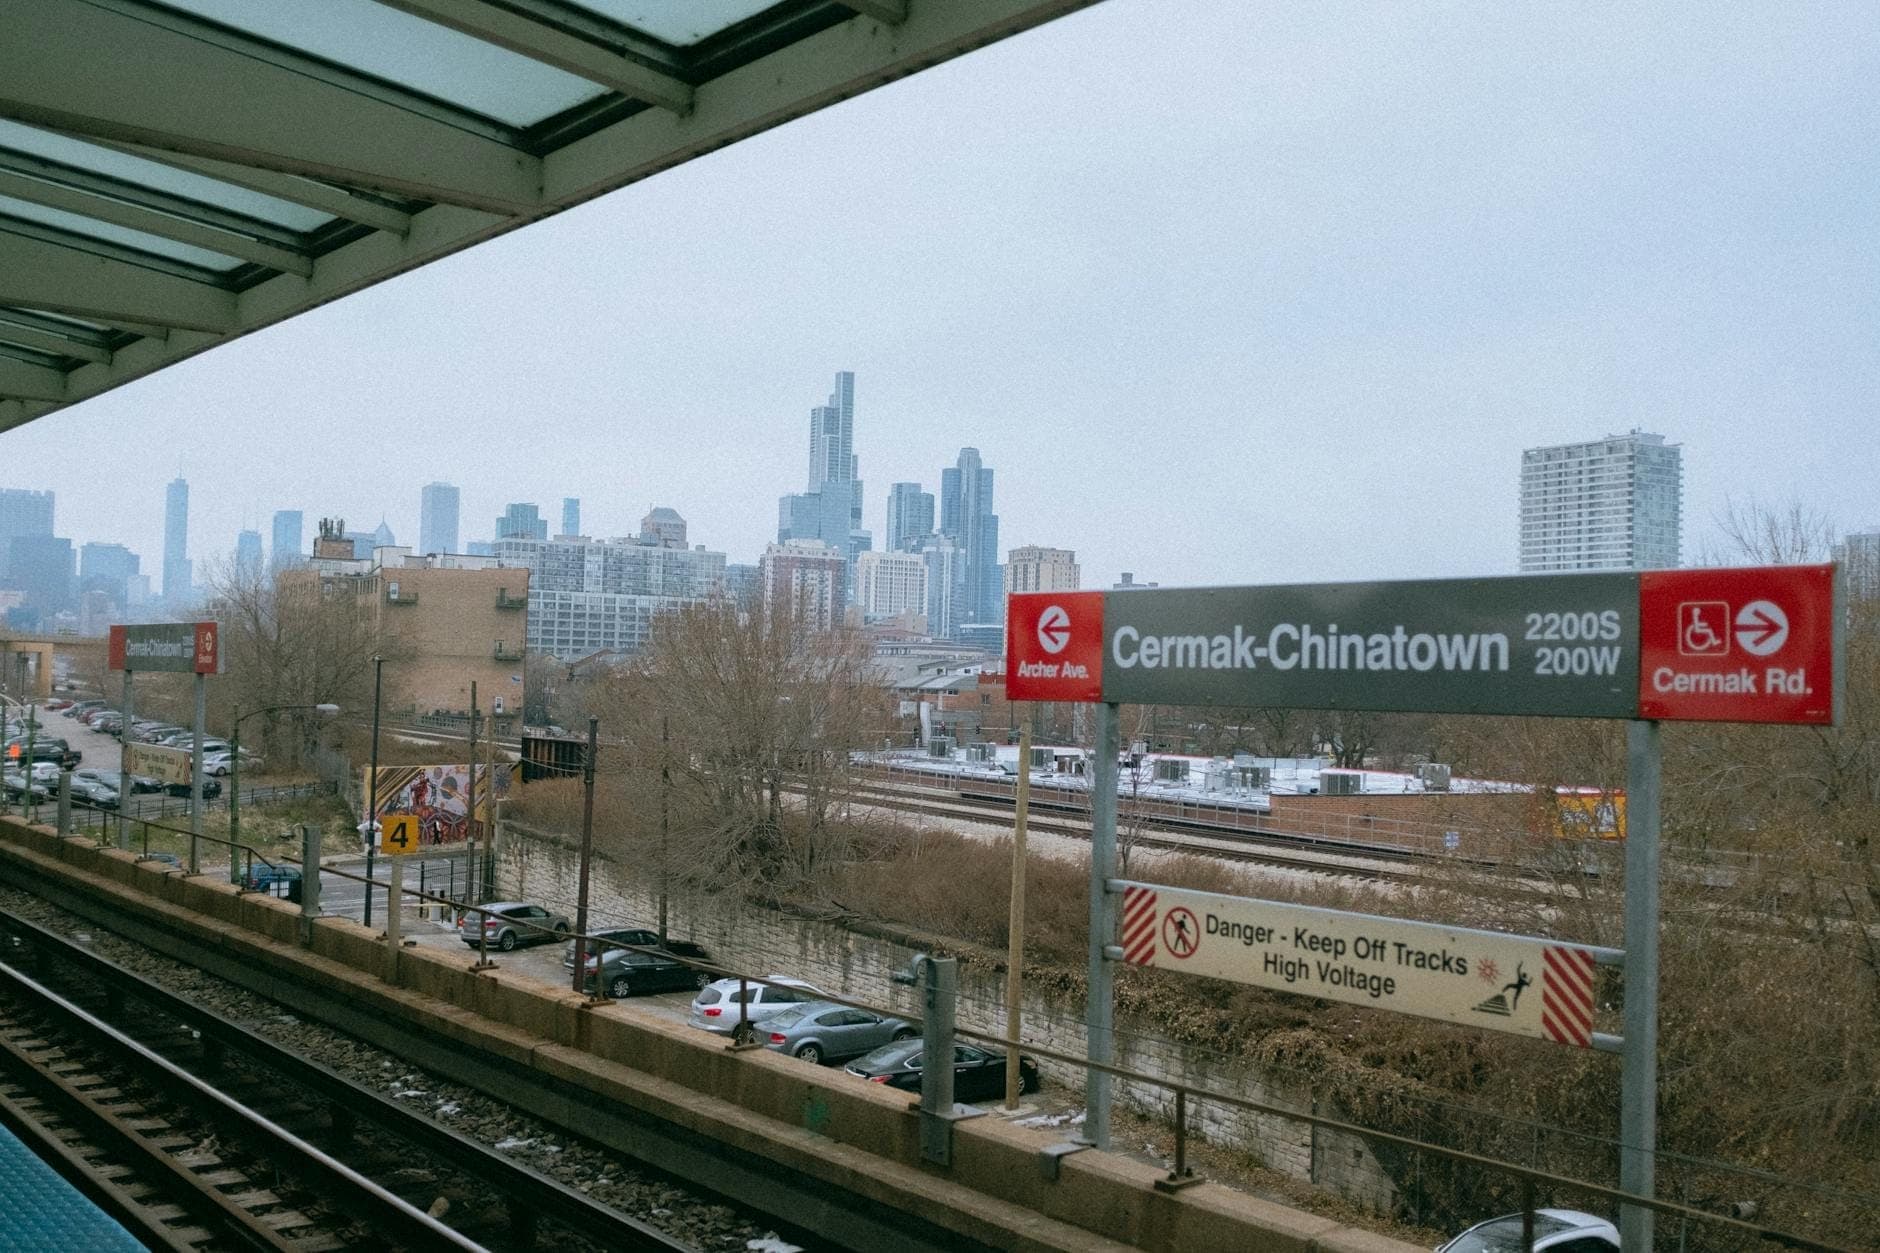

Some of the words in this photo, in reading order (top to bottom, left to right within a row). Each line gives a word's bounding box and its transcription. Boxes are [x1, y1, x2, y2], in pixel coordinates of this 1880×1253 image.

[1524, 610, 1622, 641] 2200S
[1112, 622, 1510, 672] Cermak-Chinatown
[1534, 646, 1622, 676] 200W
[1017, 660, 1058, 679] Archer
[1061, 660, 1090, 679] Ave.
[1652, 666, 1757, 694] Cermak
[1765, 667, 1814, 695] Rd.
[389, 822, 410, 849] 4
[1205, 913, 1275, 947] Danger
[1293, 926, 1347, 961] Keep
[1353, 936, 1387, 962] Off
[1393, 941, 1468, 976] Tracks
[1263, 951, 1310, 984] High
[1316, 960, 1396, 999] Voltage
